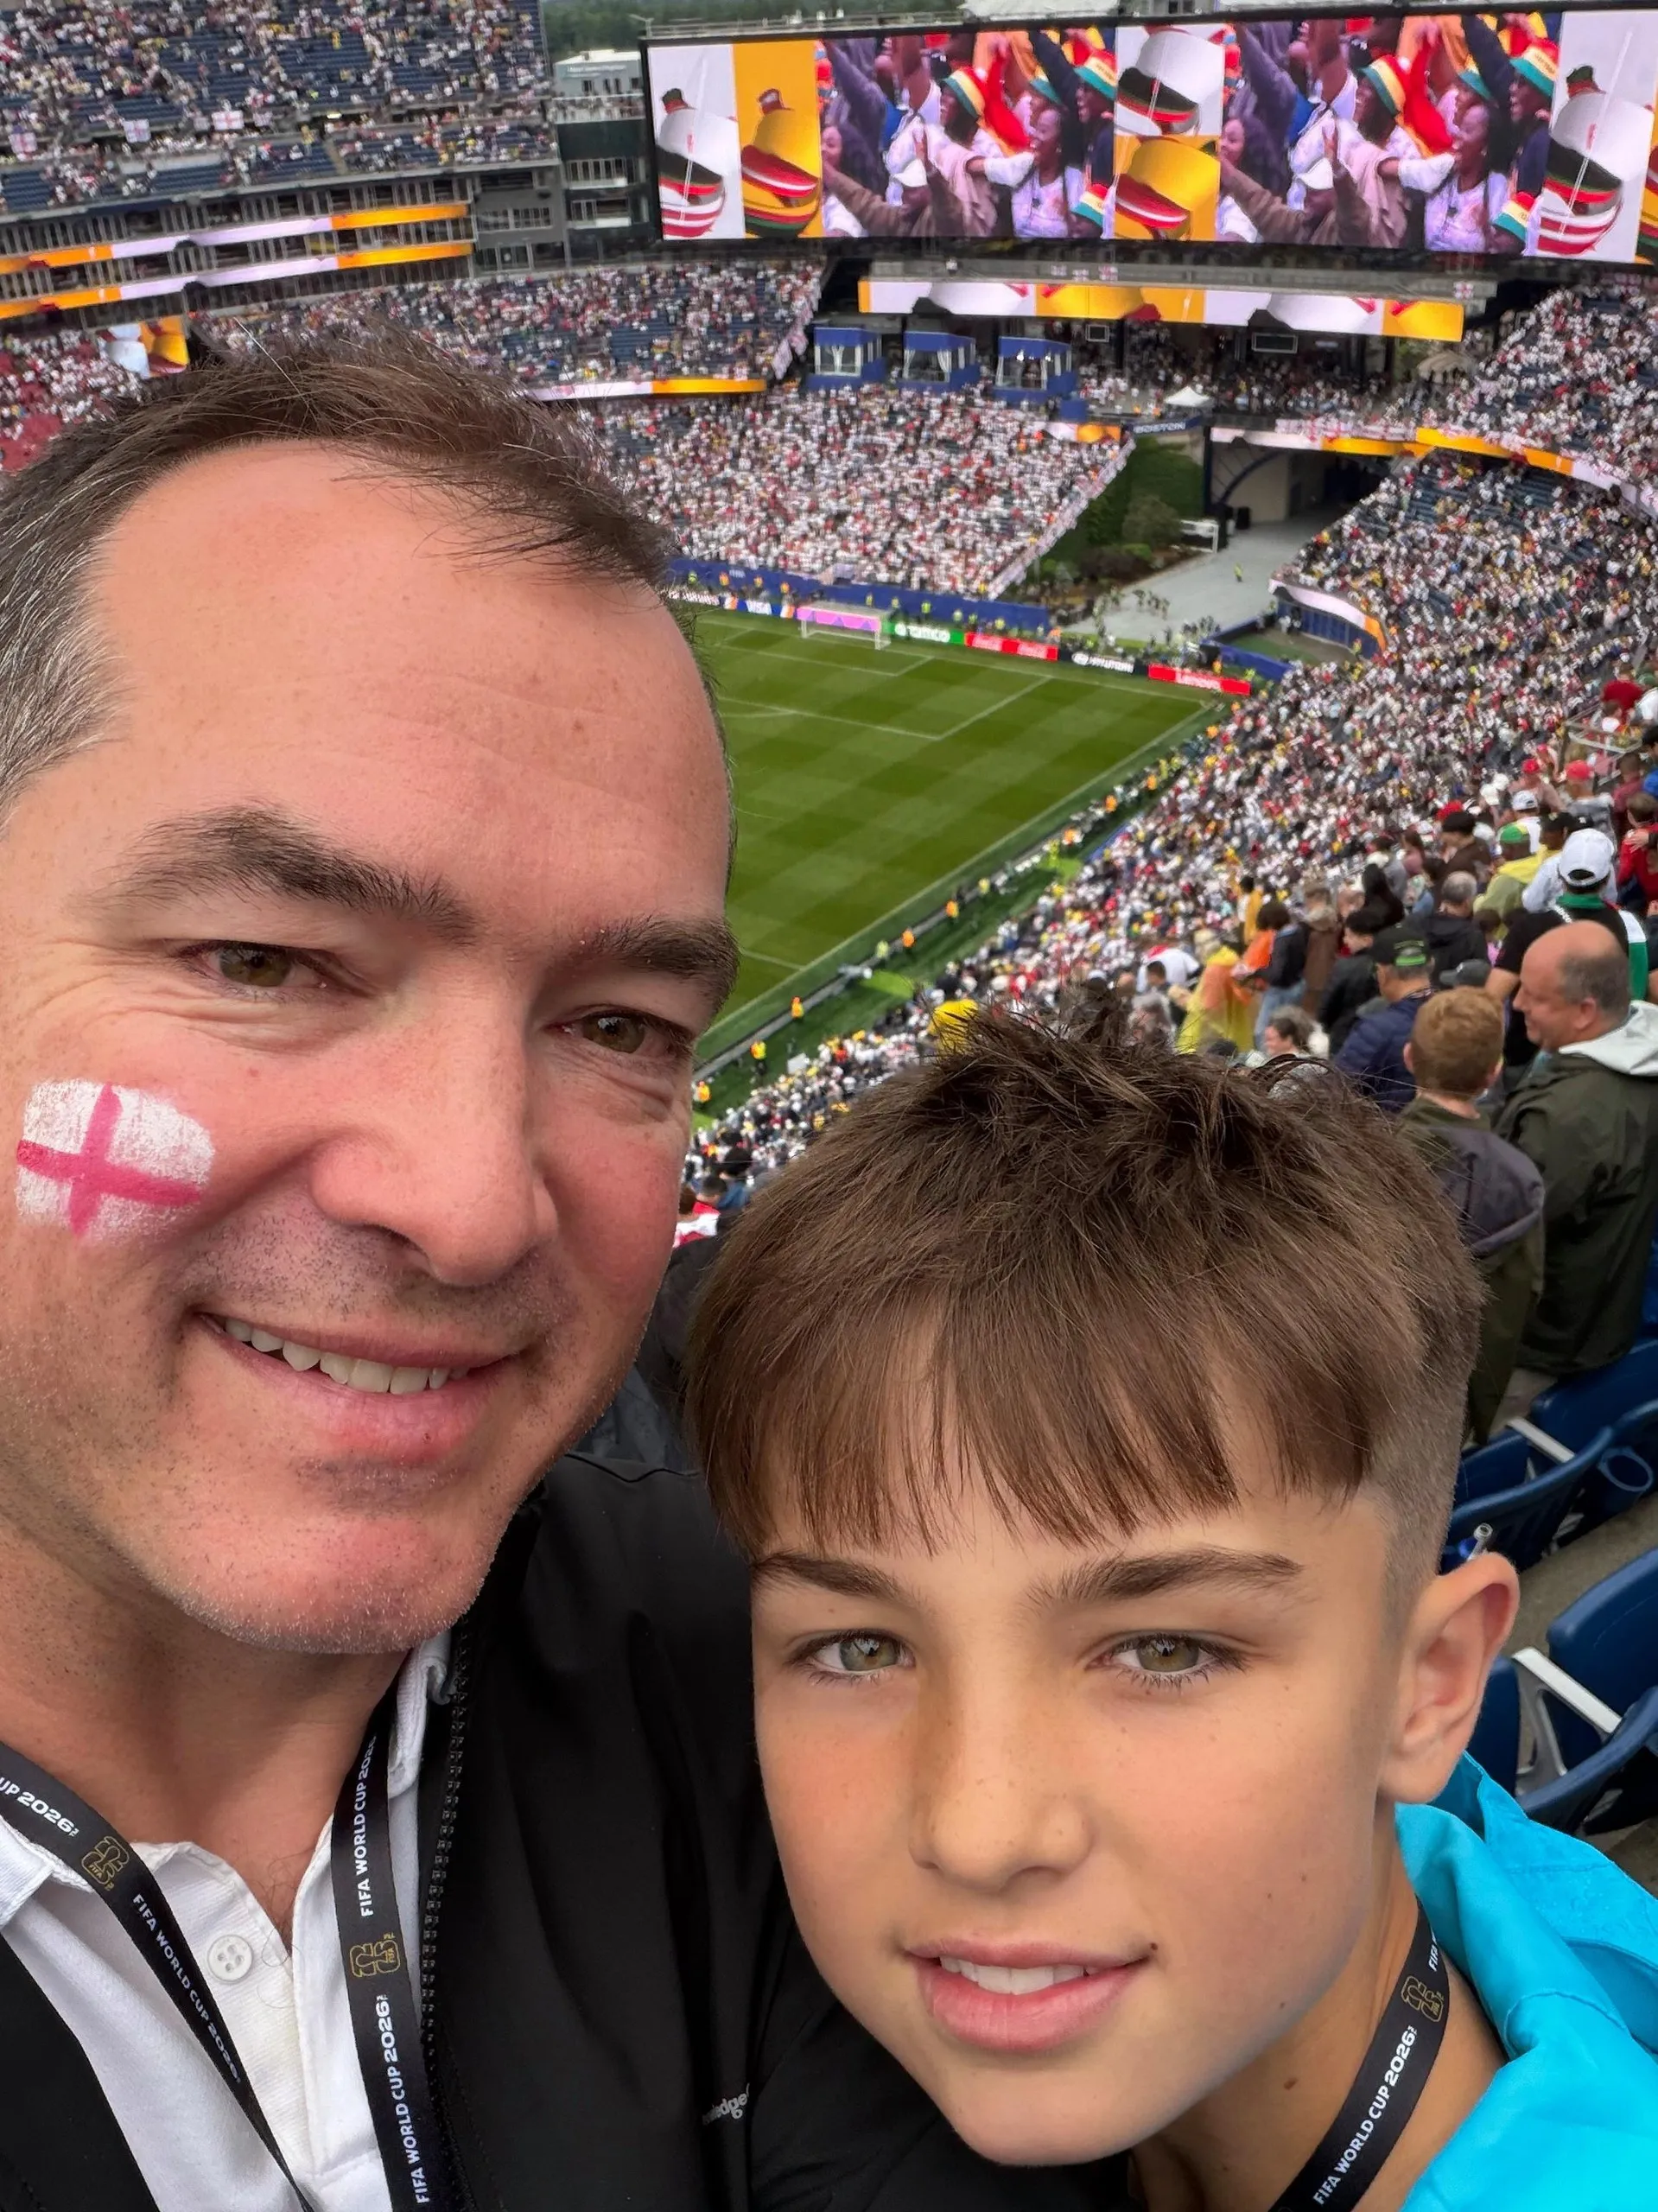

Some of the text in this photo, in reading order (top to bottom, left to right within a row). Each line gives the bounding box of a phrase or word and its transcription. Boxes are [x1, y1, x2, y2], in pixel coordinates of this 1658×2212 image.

[0, 1777, 20, 1795] UP
[354, 1783, 367, 1811] CUP
[353, 1815, 368, 1876] WORLD
[358, 1878, 373, 1917] FIFA
[133, 1894, 156, 1932] FIFA
[156, 1929, 191, 1989] WORLD
[189, 1990, 210, 2020] CUP
[387, 2065, 406, 2101] CUP
[396, 2102, 421, 2164] WORLD
[1313, 2176, 1341, 2204] FIFA
[1334, 2120, 1374, 2174] WORLD
[1369, 2085, 1390, 2120] CUP
[410, 2166, 430, 2204] FIFA
